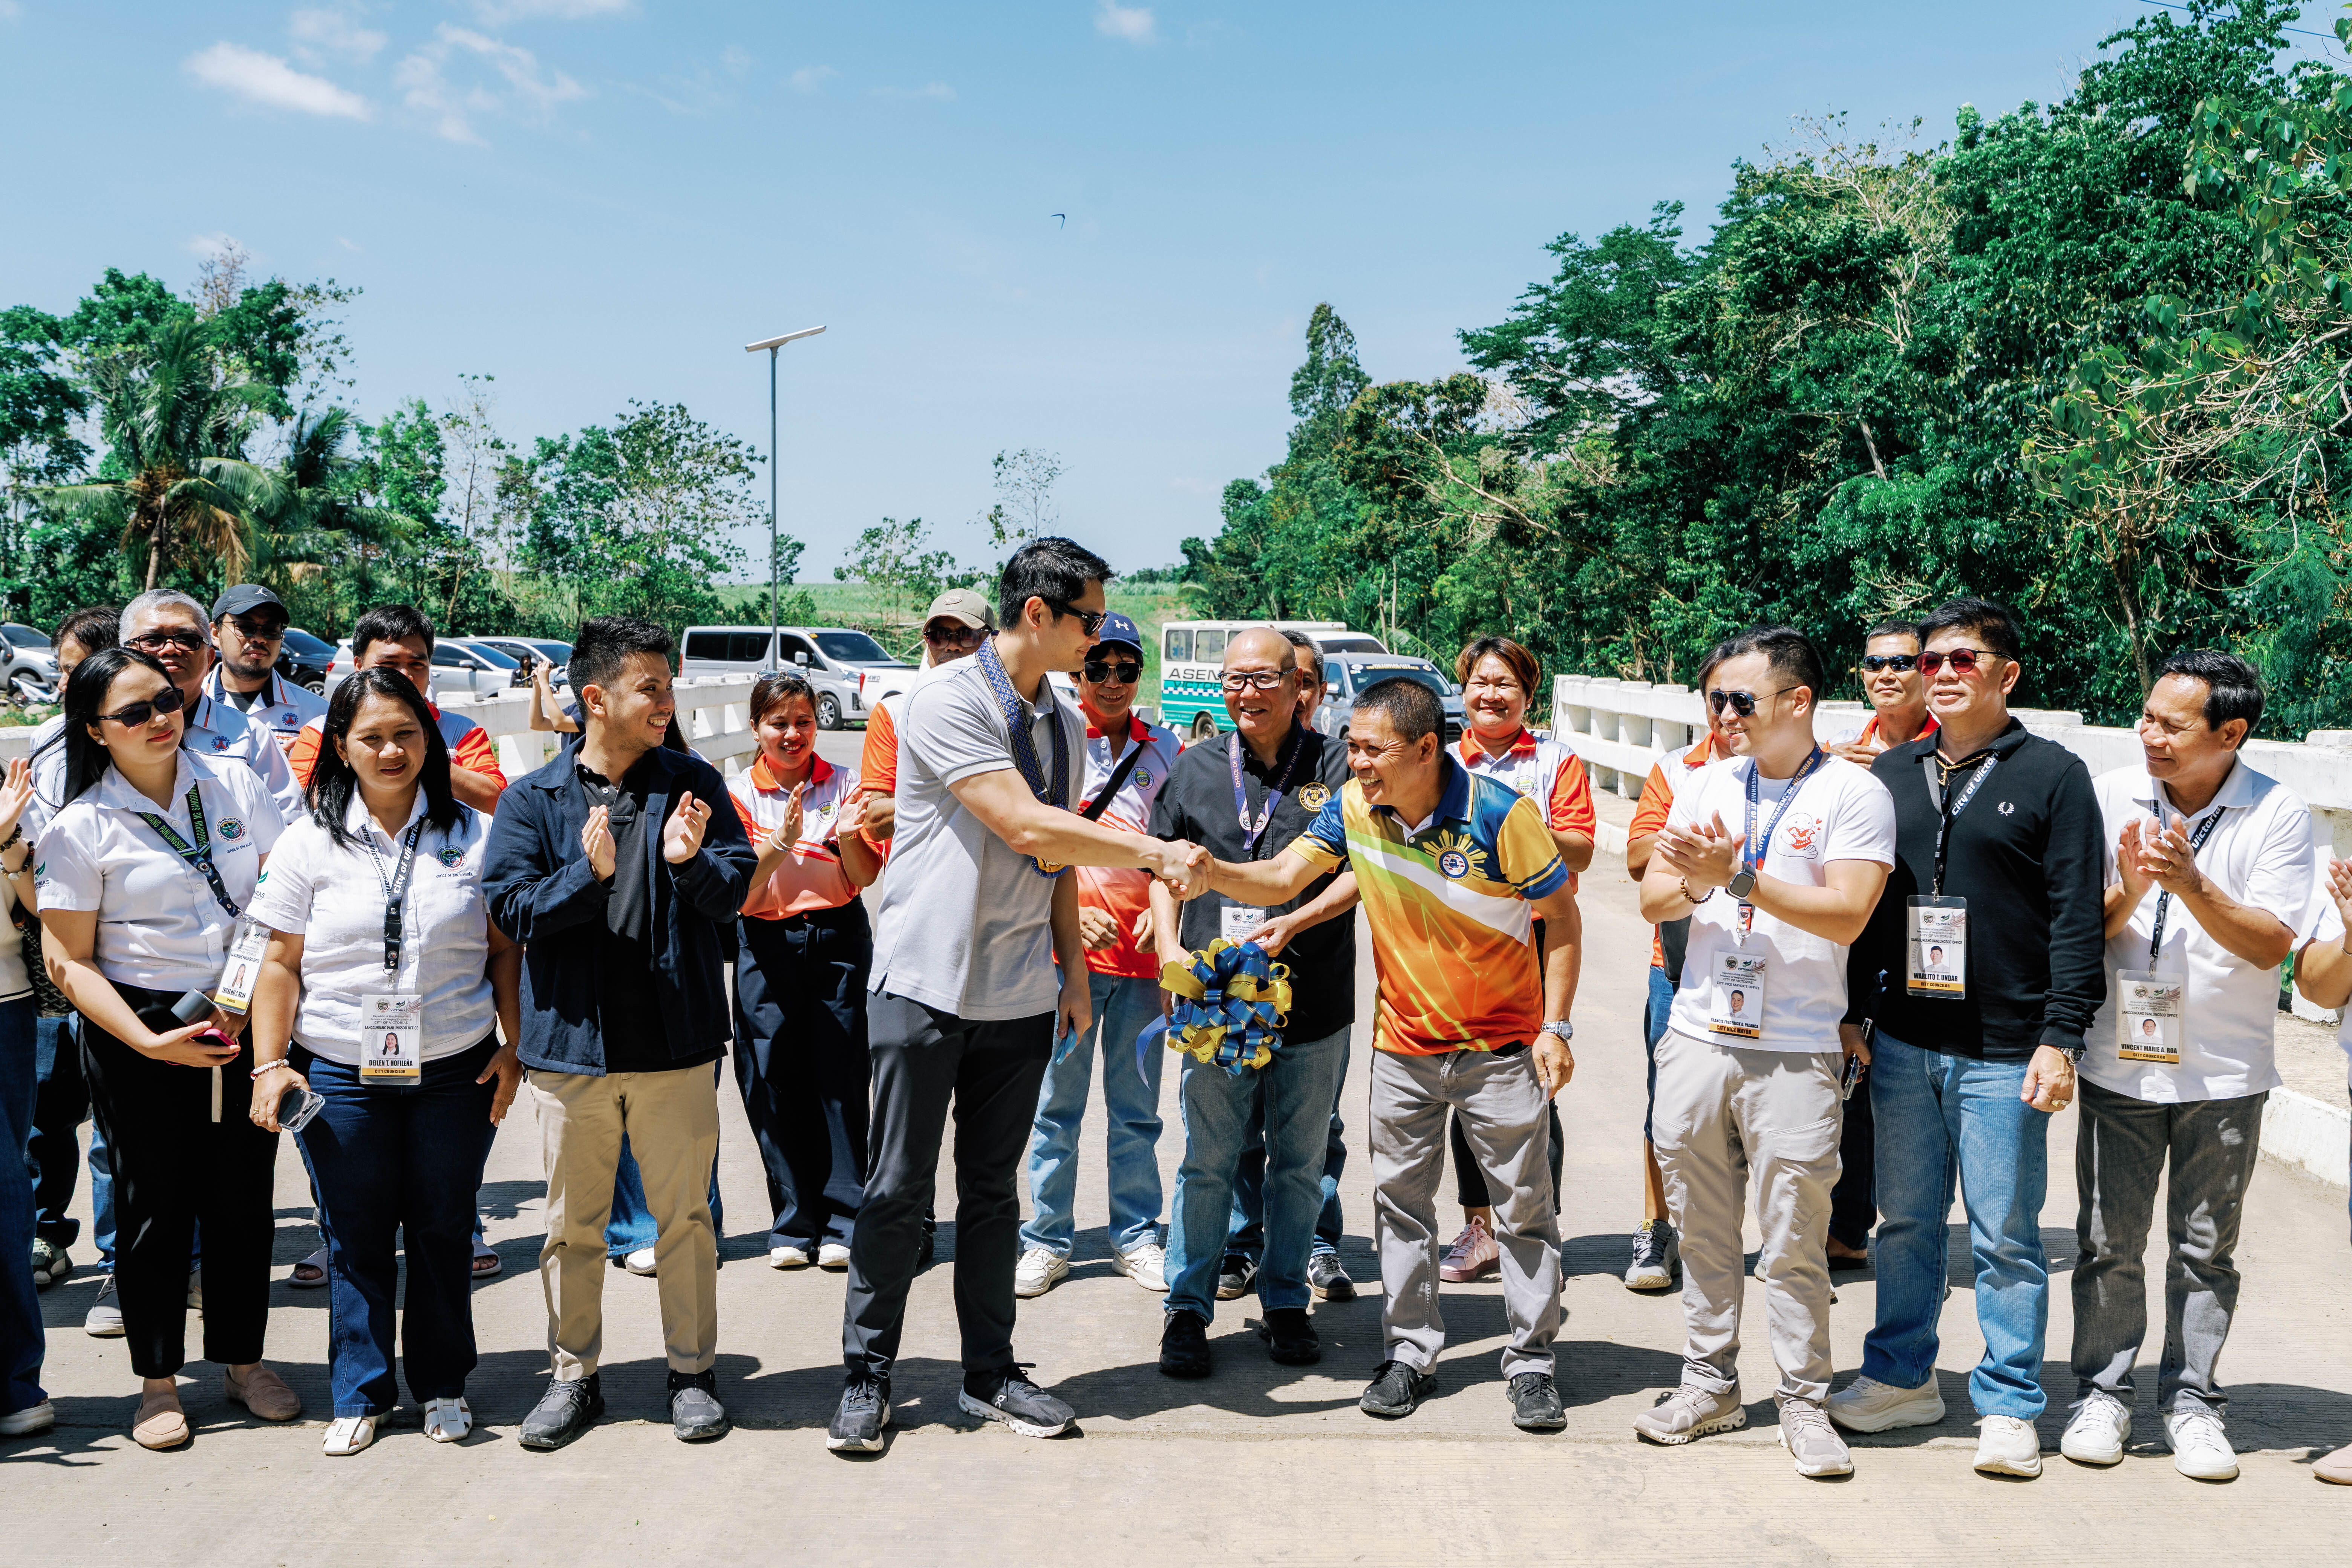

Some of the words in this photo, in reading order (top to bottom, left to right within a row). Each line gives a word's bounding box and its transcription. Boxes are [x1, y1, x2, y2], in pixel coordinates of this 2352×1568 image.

[1232, 767, 1241, 788] OFFICE
[1277, 773, 1288, 790] OFFICE
[1757, 839, 1766, 851] CITY
[1762, 793, 1788, 838] GOVERNMENT
[1792, 757, 1814, 786] VICTORIAS
[1952, 794, 1968, 816] City
[1966, 781, 1975, 795] of
[228, 818, 245, 828] VICTORIAS
[1751, 810, 1757, 820] OF
[158, 825, 187, 851] PANLUNGSOD
[194, 821, 208, 847] TANGGAPAN
[452, 846, 466, 859] VICTORIAS
[394, 874, 406, 894] City
[401, 861, 408, 873] of
[1462, 871, 1472, 880] CHAPTER
